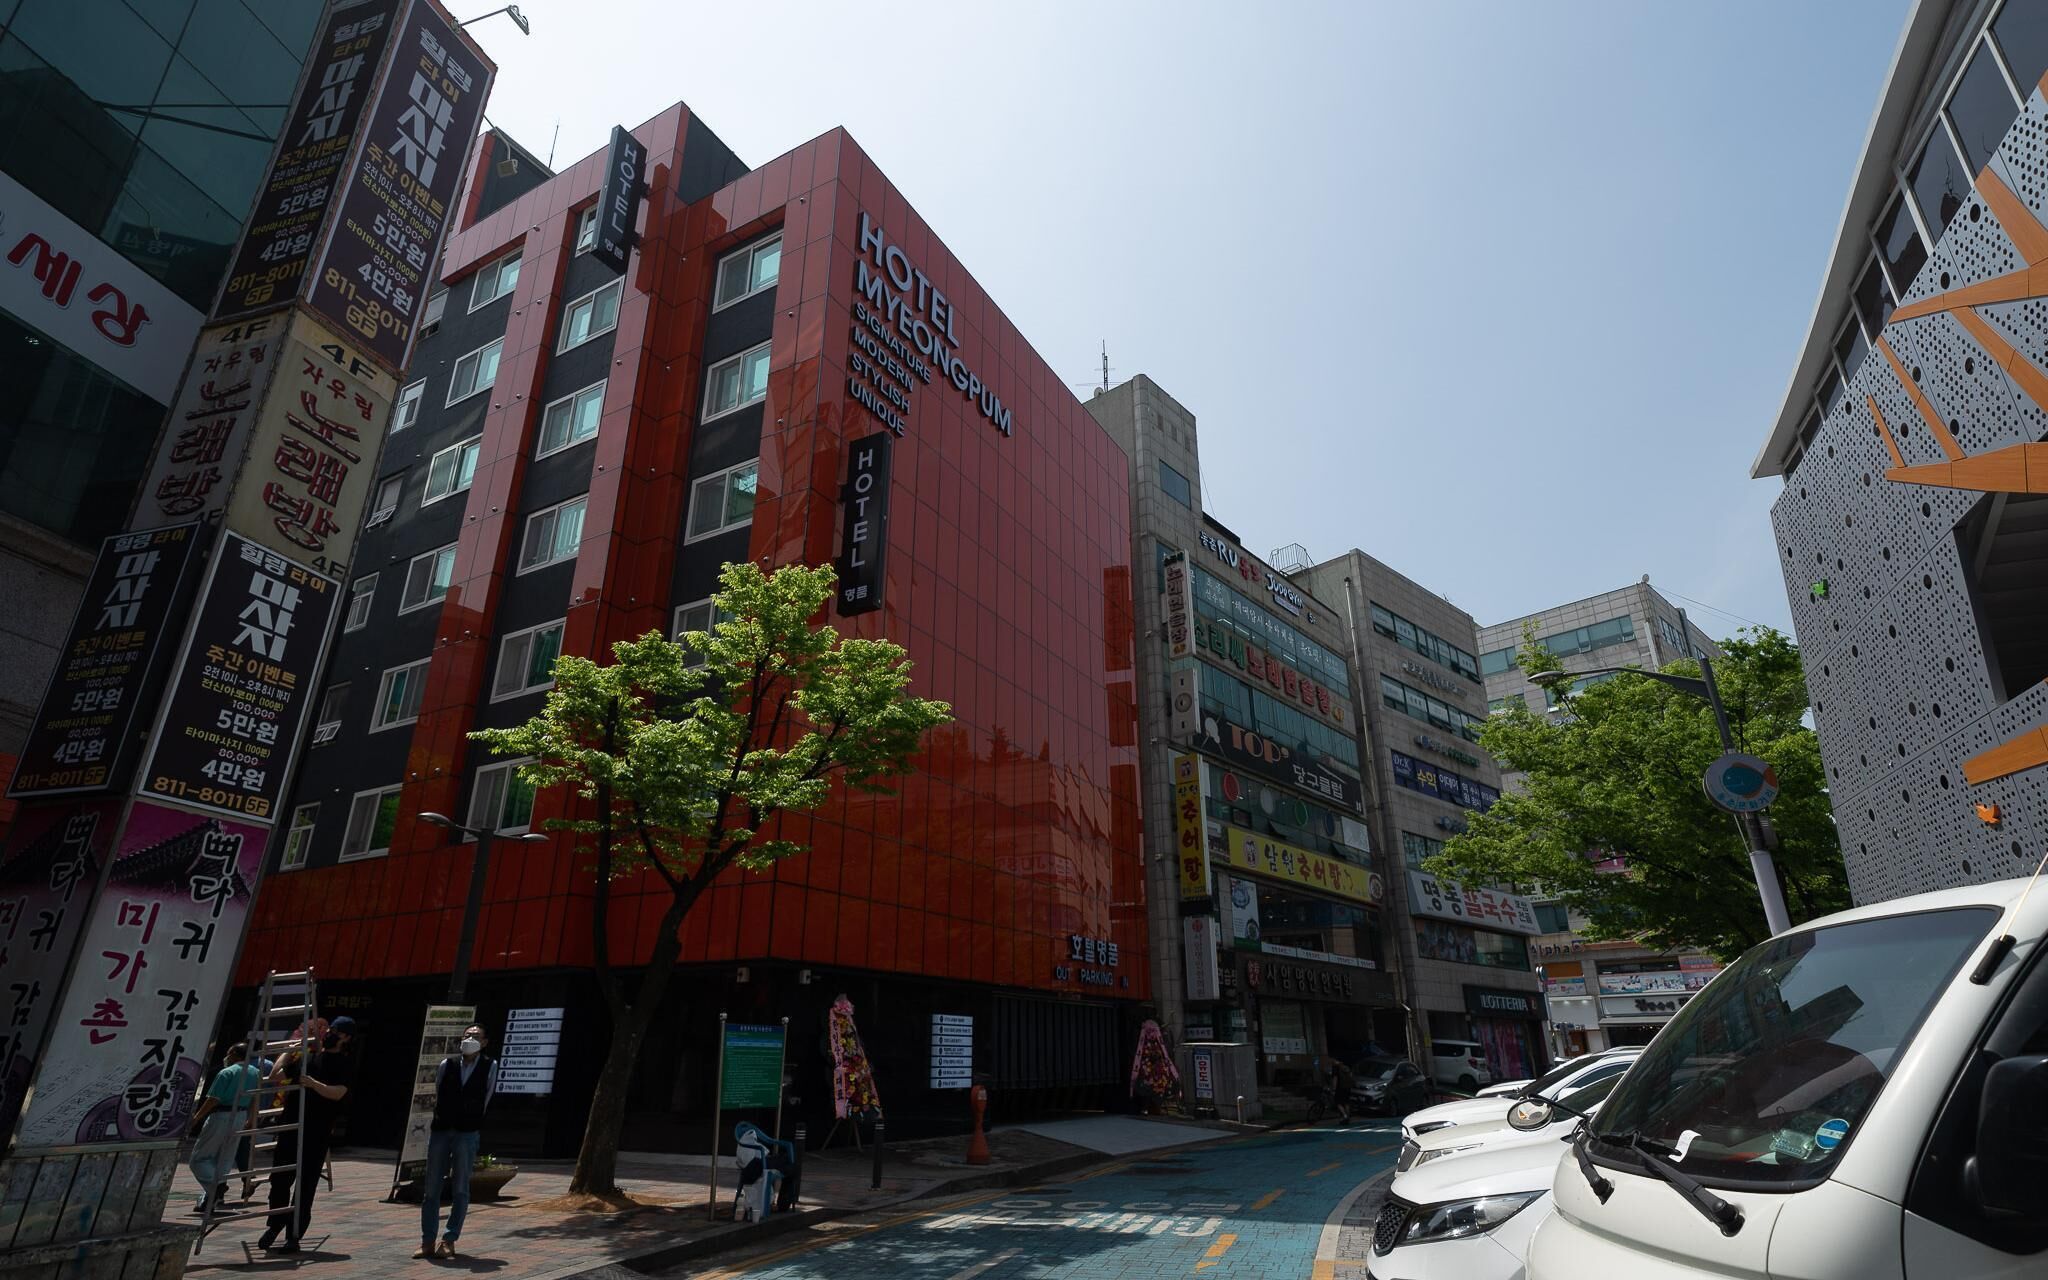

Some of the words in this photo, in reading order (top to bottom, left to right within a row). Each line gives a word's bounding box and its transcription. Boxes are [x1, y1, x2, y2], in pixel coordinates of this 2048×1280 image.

[419, 55, 460, 103] 타이
[420, 25, 472, 93] 힐링
[298, 53, 365, 147] 마사지
[388, 70, 454, 189] 마사지
[277, 185, 329, 216] 5만원
[367, 141, 399, 180] 주간
[400, 172, 445, 220] 이벤트
[612, 143, 637, 234] HOTEL
[259, 231, 313, 263] 4만원
[346, 218, 394, 264] 타이마사지
[373, 213, 427, 272] 5만원
[325, 267, 409, 342] 811-8011
[358, 262, 414, 317] 4만원
[860, 211, 960, 348] HOTEL
[220, 319, 271, 343] 4F
[853, 327, 914, 393] MODERN
[856, 302, 931, 384] SIGNATURE
[857, 260, 1012, 437] MYEONGPUM
[303, 358, 373, 421] 자우림
[321, 344, 377, 380] 4F
[851, 353, 911, 415] STYLISH
[849, 378, 905, 437] UNIQUE
[156, 378, 252, 515] 노래방
[263, 390, 361, 551] 노래방
[851, 449, 872, 568] HOTEL
[95, 550, 160, 631] 마사지
[240, 543, 288, 577] 힐링
[290, 567, 327, 594] 타이
[311, 556, 346, 577] 4F
[231, 571, 303, 663] 마사지
[200, 677, 256, 703] 전신아로마
[202, 664, 221, 681] 오전
[221, 669, 239, 685] 10시
[205, 643, 245, 671] 주간
[246, 659, 297, 690] 이벤트
[70, 687, 124, 712] 5만원
[216, 708, 280, 745] 5만원
[52, 738, 107, 764] 4만원
[184, 725, 242, 750] 타이마사지
[153, 775, 242, 809] 811-8011
[200, 759, 267, 793] 4만원
[1181, 800, 1203, 882] 추어탕
[80, 902, 160, 1044] 미가촌
[1080, 968, 1113, 985] PARKING
[1480, 994, 1529, 1011] LOTTERIA
